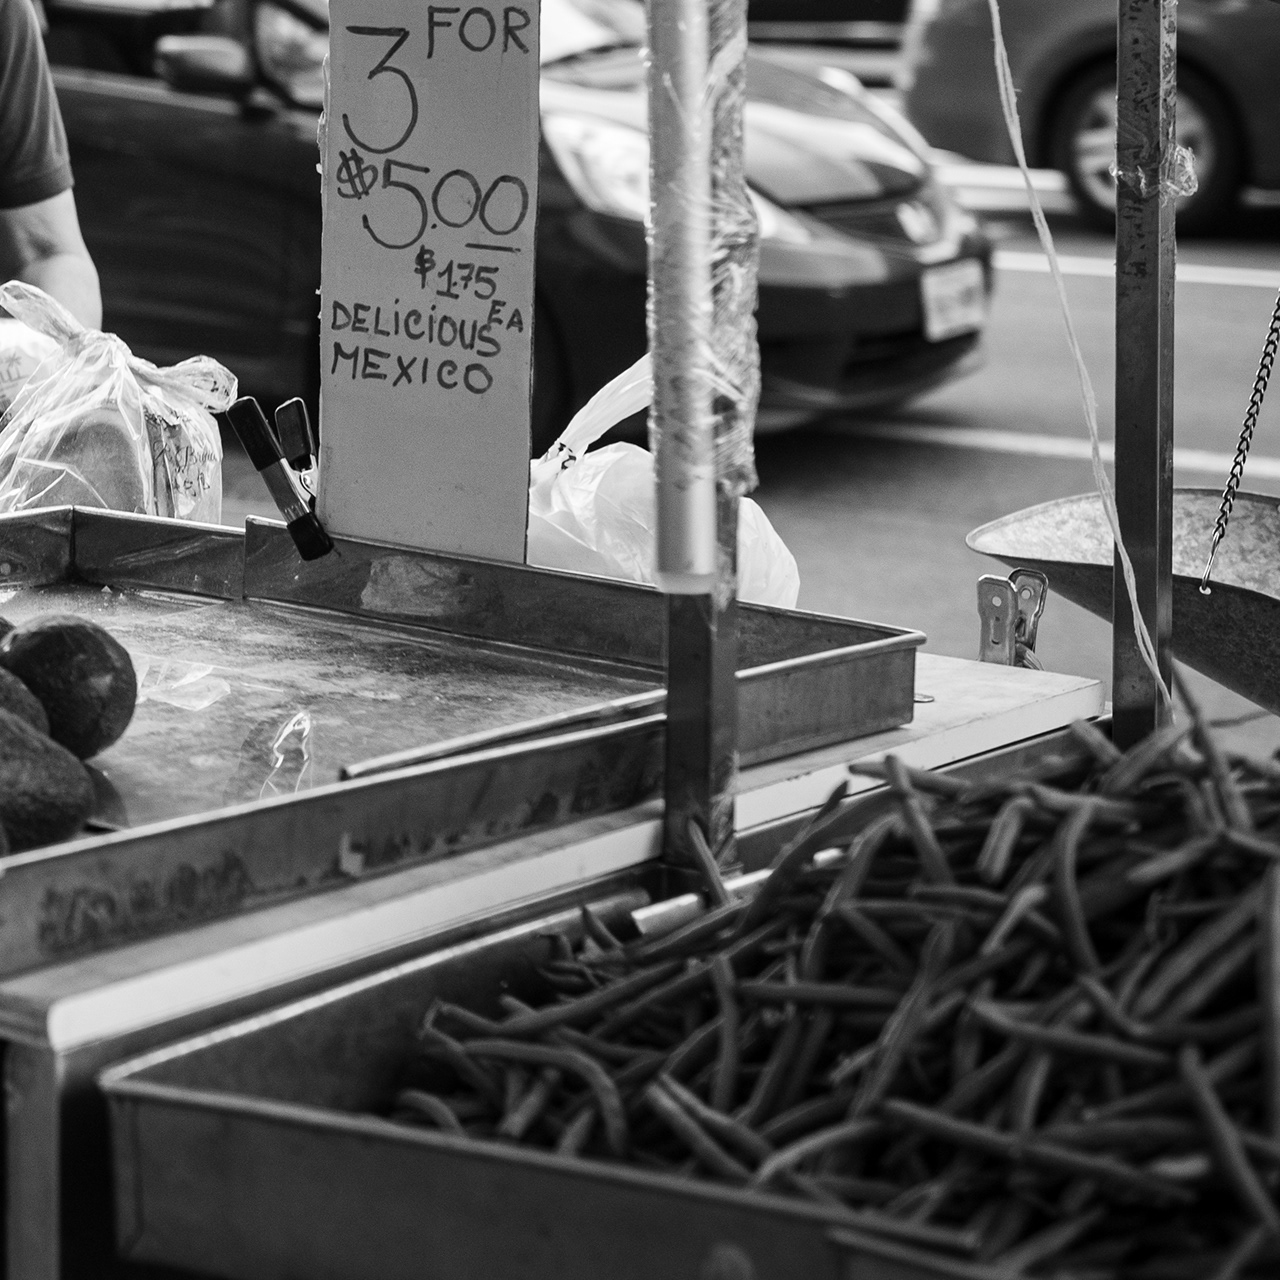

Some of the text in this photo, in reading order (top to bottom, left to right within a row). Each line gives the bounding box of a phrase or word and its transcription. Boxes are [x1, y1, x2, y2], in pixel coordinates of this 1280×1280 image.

[341, 4, 531, 155] 3 FOR
[489, 299, 524, 334] EA
[331, 341, 494, 395] MEXICO
